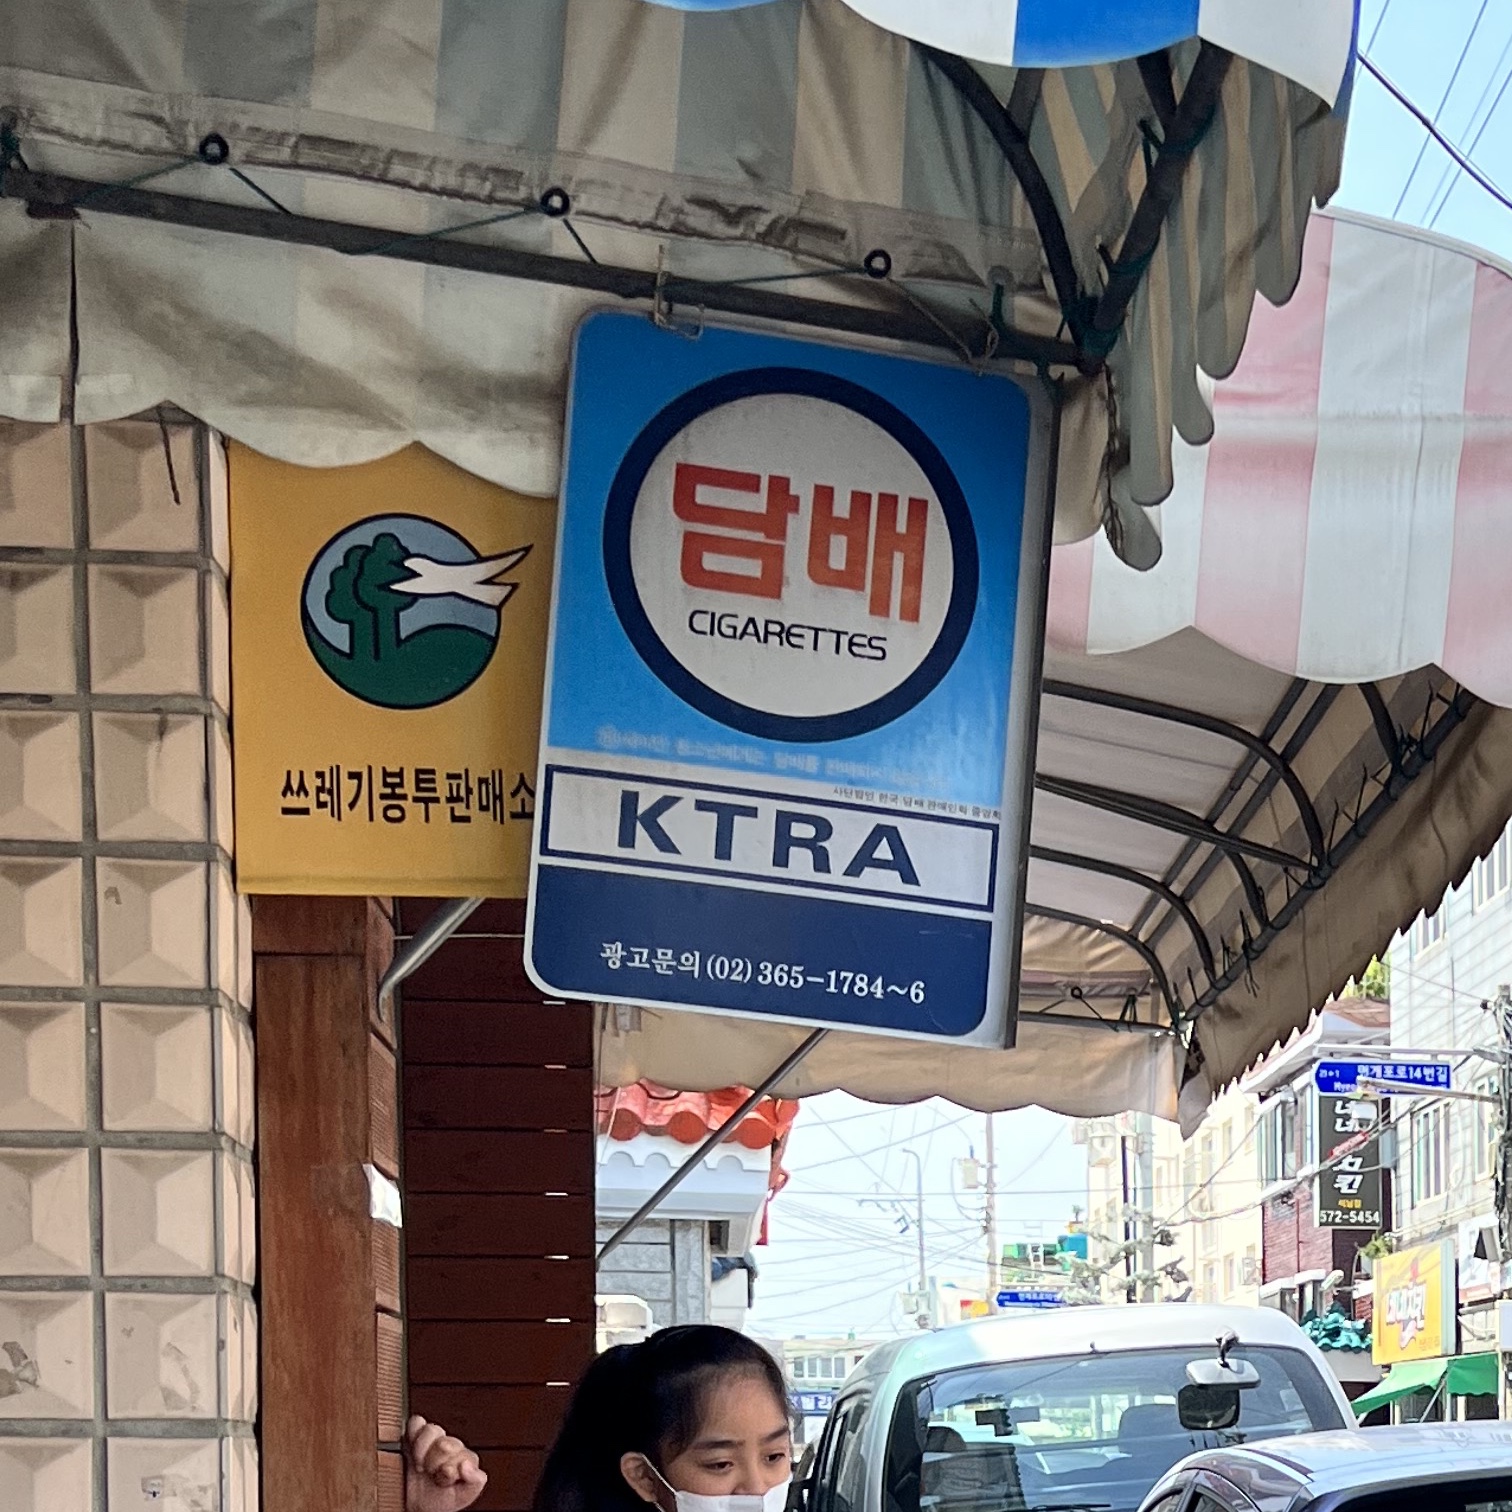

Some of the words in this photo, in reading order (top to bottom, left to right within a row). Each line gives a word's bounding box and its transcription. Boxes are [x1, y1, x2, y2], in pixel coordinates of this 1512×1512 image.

[672, 462, 930, 624] 담배
[687, 608, 888, 662] CIGARETTES
[281, 764, 536, 825] 쓰레기봉투판매소
[617, 789, 921, 887] KTRA
[600, 941, 701, 979] 광고문의
[706, 953, 753, 984] (02)
[1319, 1210, 1380, 1223] 572-5454
